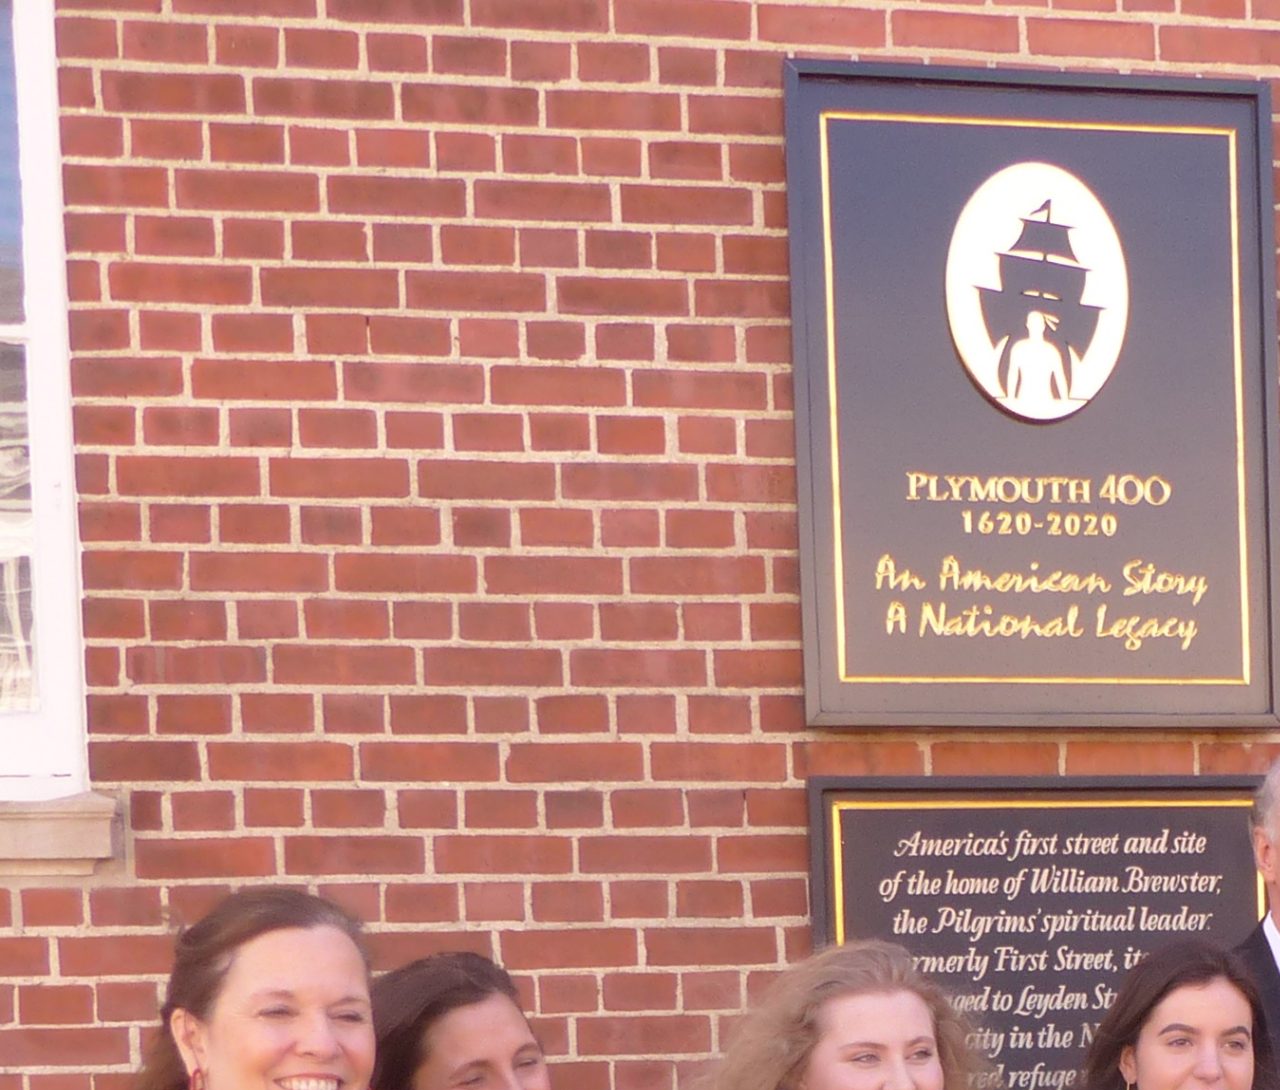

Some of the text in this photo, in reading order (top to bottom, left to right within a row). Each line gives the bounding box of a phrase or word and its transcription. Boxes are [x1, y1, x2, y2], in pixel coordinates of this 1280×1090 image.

[905, 471, 1172, 506] PLYMOUTH 400
[961, 509, 1118, 537] 1620-2020
[874, 553, 1209, 606] An American Story
[885, 600, 1199, 651] A National Legacy
[893, 828, 1208, 862] America's first street and site
[878, 864, 1223, 903] of the home of William Brewster,
[893, 905, 1214, 943] the Pilgrims' spiritual leader.
[911, 946, 991, 981] rmerly
[993, 946, 1050, 973] First
[1053, 944, 1119, 974] Street,
[991, 990, 1013, 1012] to
[1012, 984, 1089, 1020] Leyden
[1008, 1025, 1034, 1049] in
[1036, 1023, 1075, 1049] the
